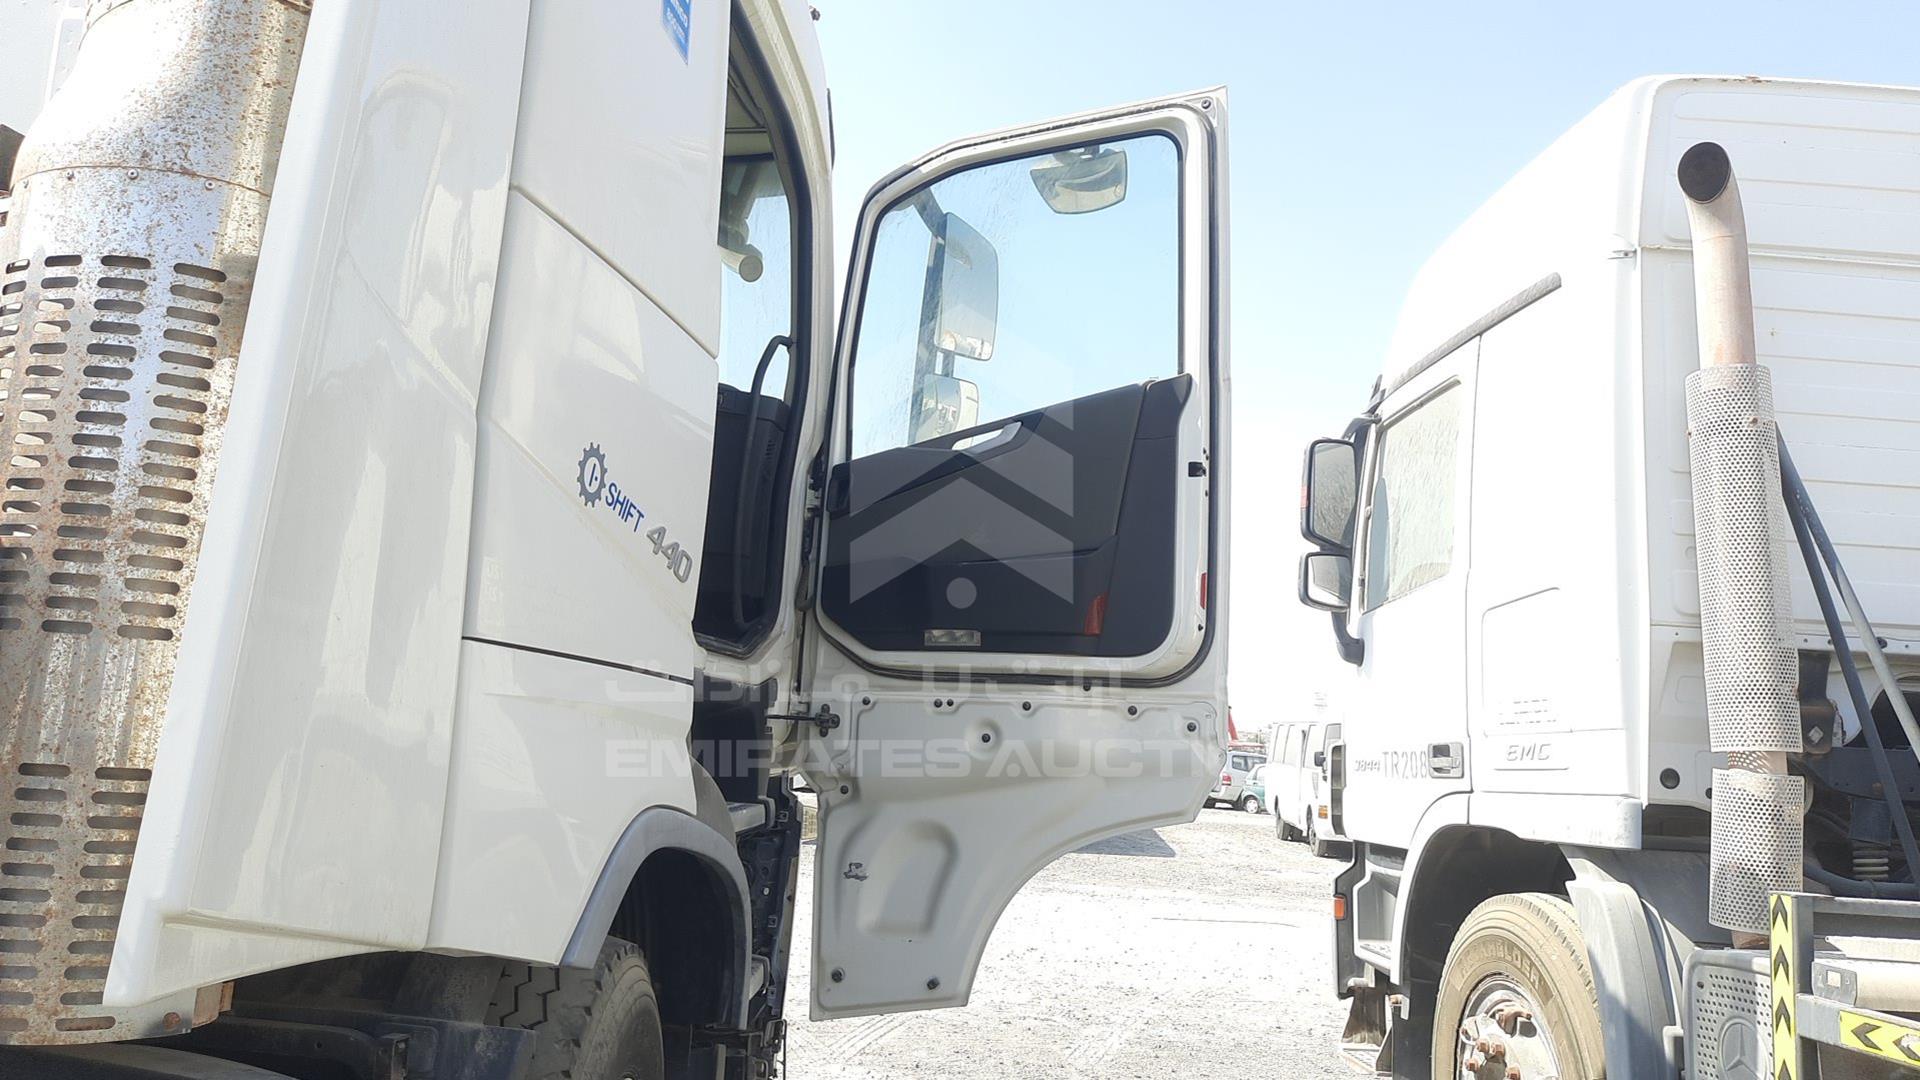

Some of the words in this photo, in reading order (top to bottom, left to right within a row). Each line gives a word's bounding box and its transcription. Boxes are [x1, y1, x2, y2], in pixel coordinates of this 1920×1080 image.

[605, 482, 645, 533] SHIFT
[646, 525, 693, 583] 440
[1382, 751, 1428, 779] TR208
[1506, 743, 1552, 762] EMC
